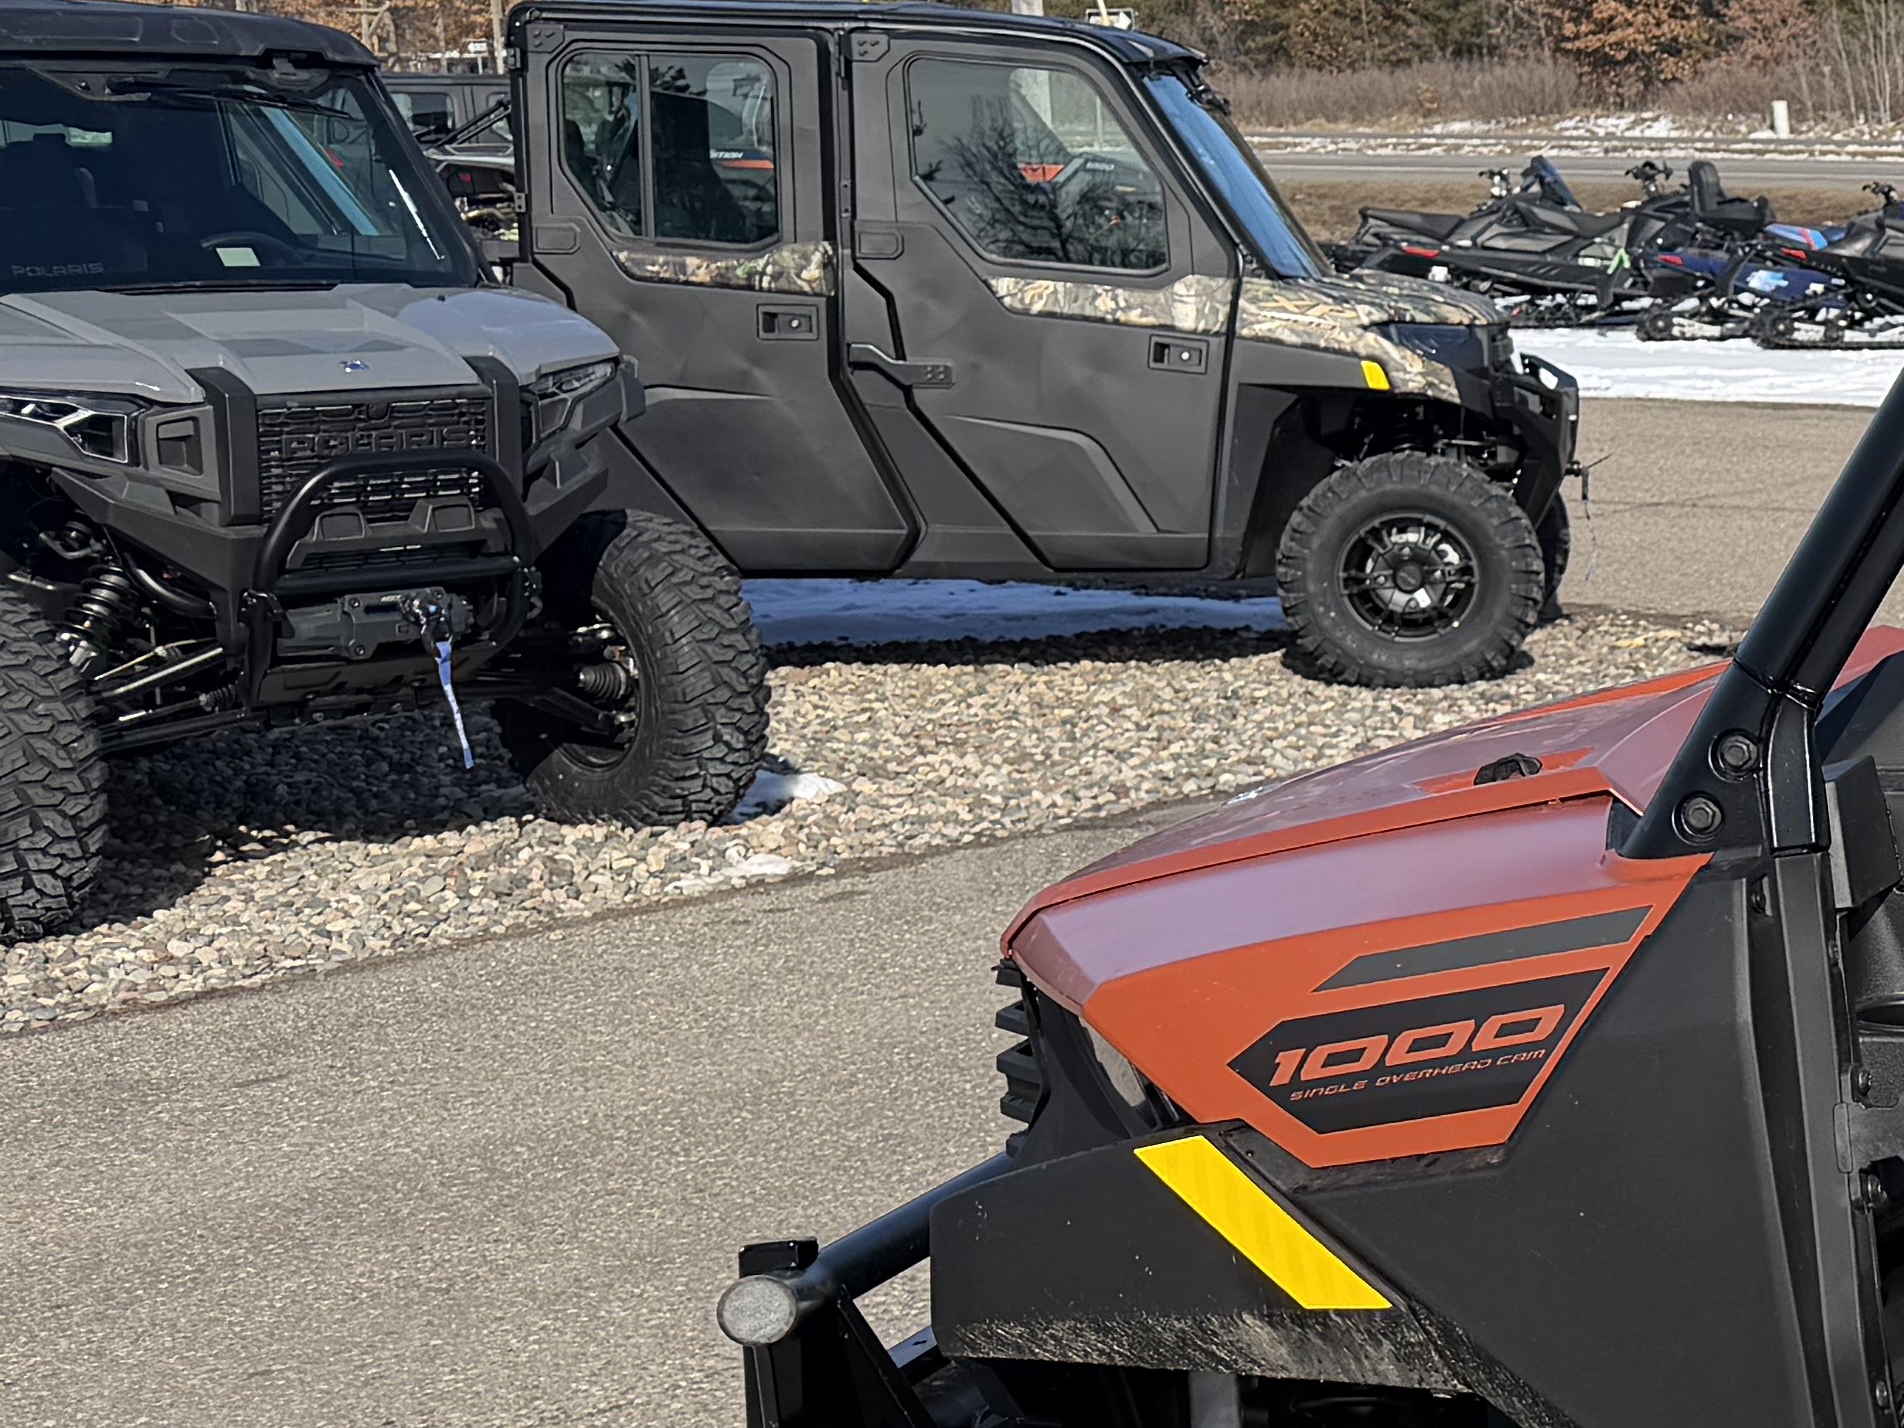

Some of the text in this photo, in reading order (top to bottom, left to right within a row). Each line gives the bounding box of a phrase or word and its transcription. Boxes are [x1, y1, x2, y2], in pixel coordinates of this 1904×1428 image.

[11, 261, 105, 277] POLARIS
[1268, 1004, 1566, 1087] 1000
[1289, 1048, 1547, 1101] SINGLE OVERHEAD CAM
